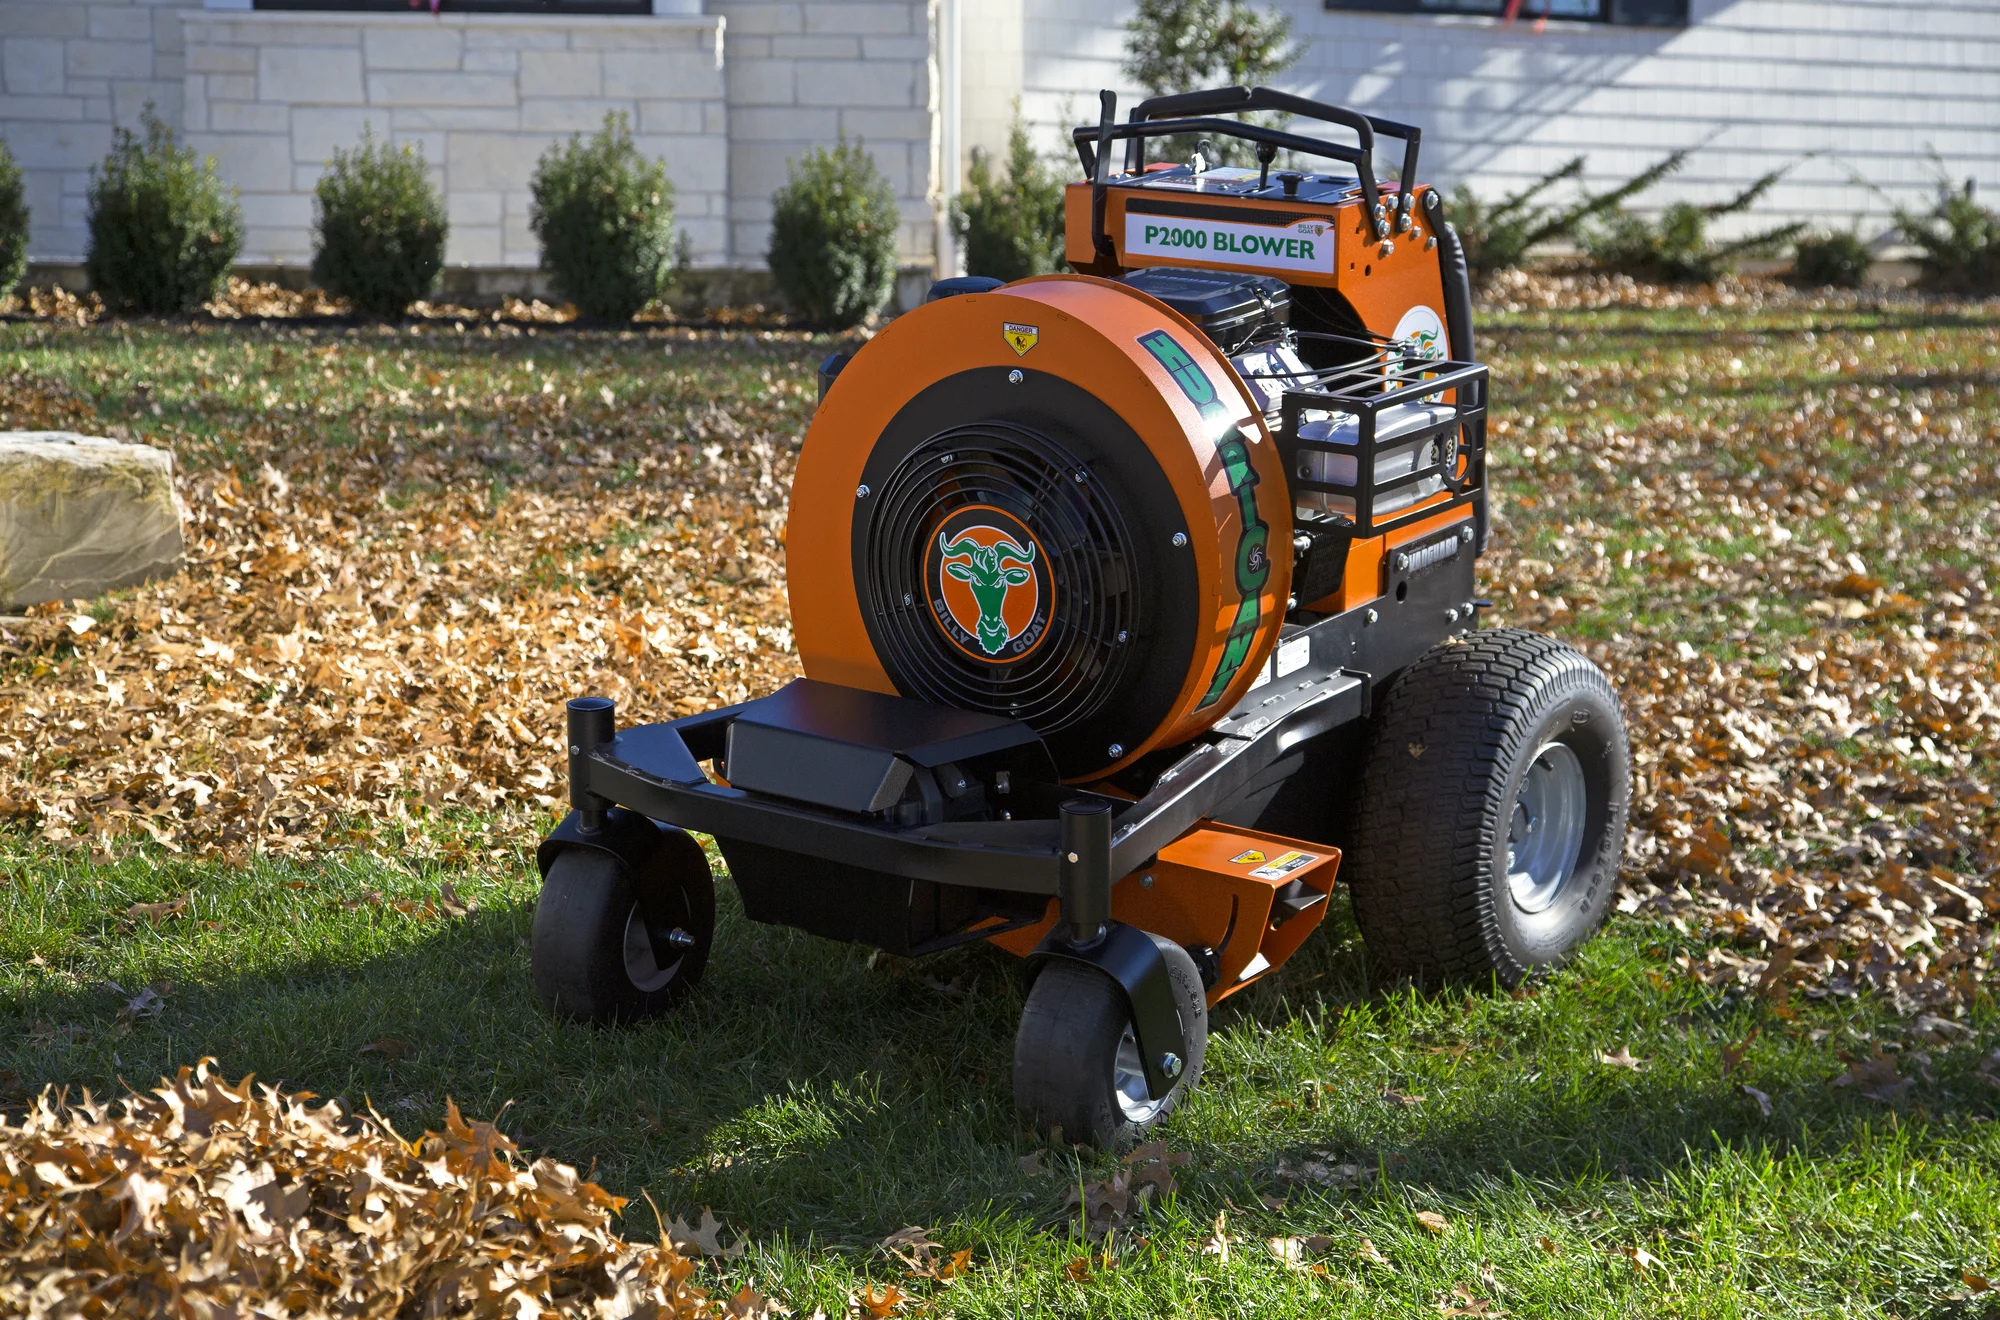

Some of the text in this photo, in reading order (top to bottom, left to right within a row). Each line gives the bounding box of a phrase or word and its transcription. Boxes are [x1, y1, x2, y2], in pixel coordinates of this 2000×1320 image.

[1145, 225, 1316, 260] P2000 BLOWER
[1008, 325, 1034, 334] DANGER
[1408, 535, 1458, 573] VANGUARD
[933, 598, 1046, 653] BILLY GOAT
